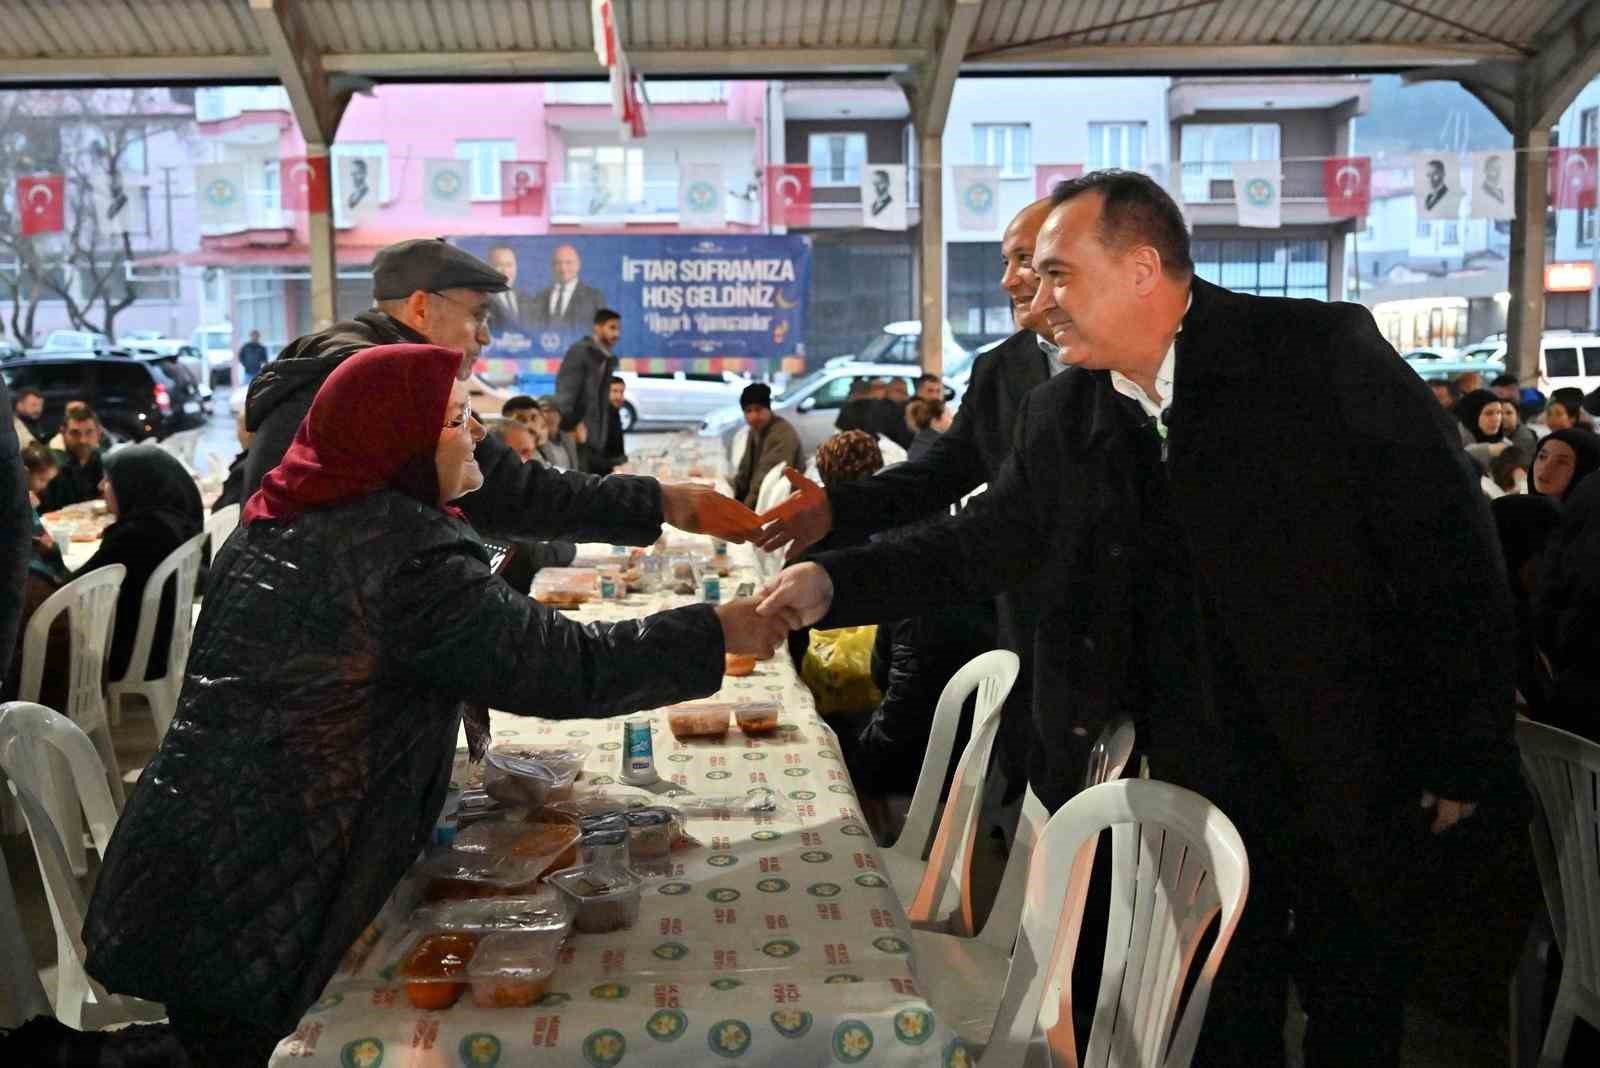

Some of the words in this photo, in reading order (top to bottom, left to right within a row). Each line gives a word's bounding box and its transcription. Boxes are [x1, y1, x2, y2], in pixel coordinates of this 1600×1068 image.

[622, 255, 677, 282] İFTAR
[680, 258, 795, 282] SOFRAMIZA
[642, 285, 684, 313] HOŞ
[685, 281, 774, 308] GELDİNİZ
